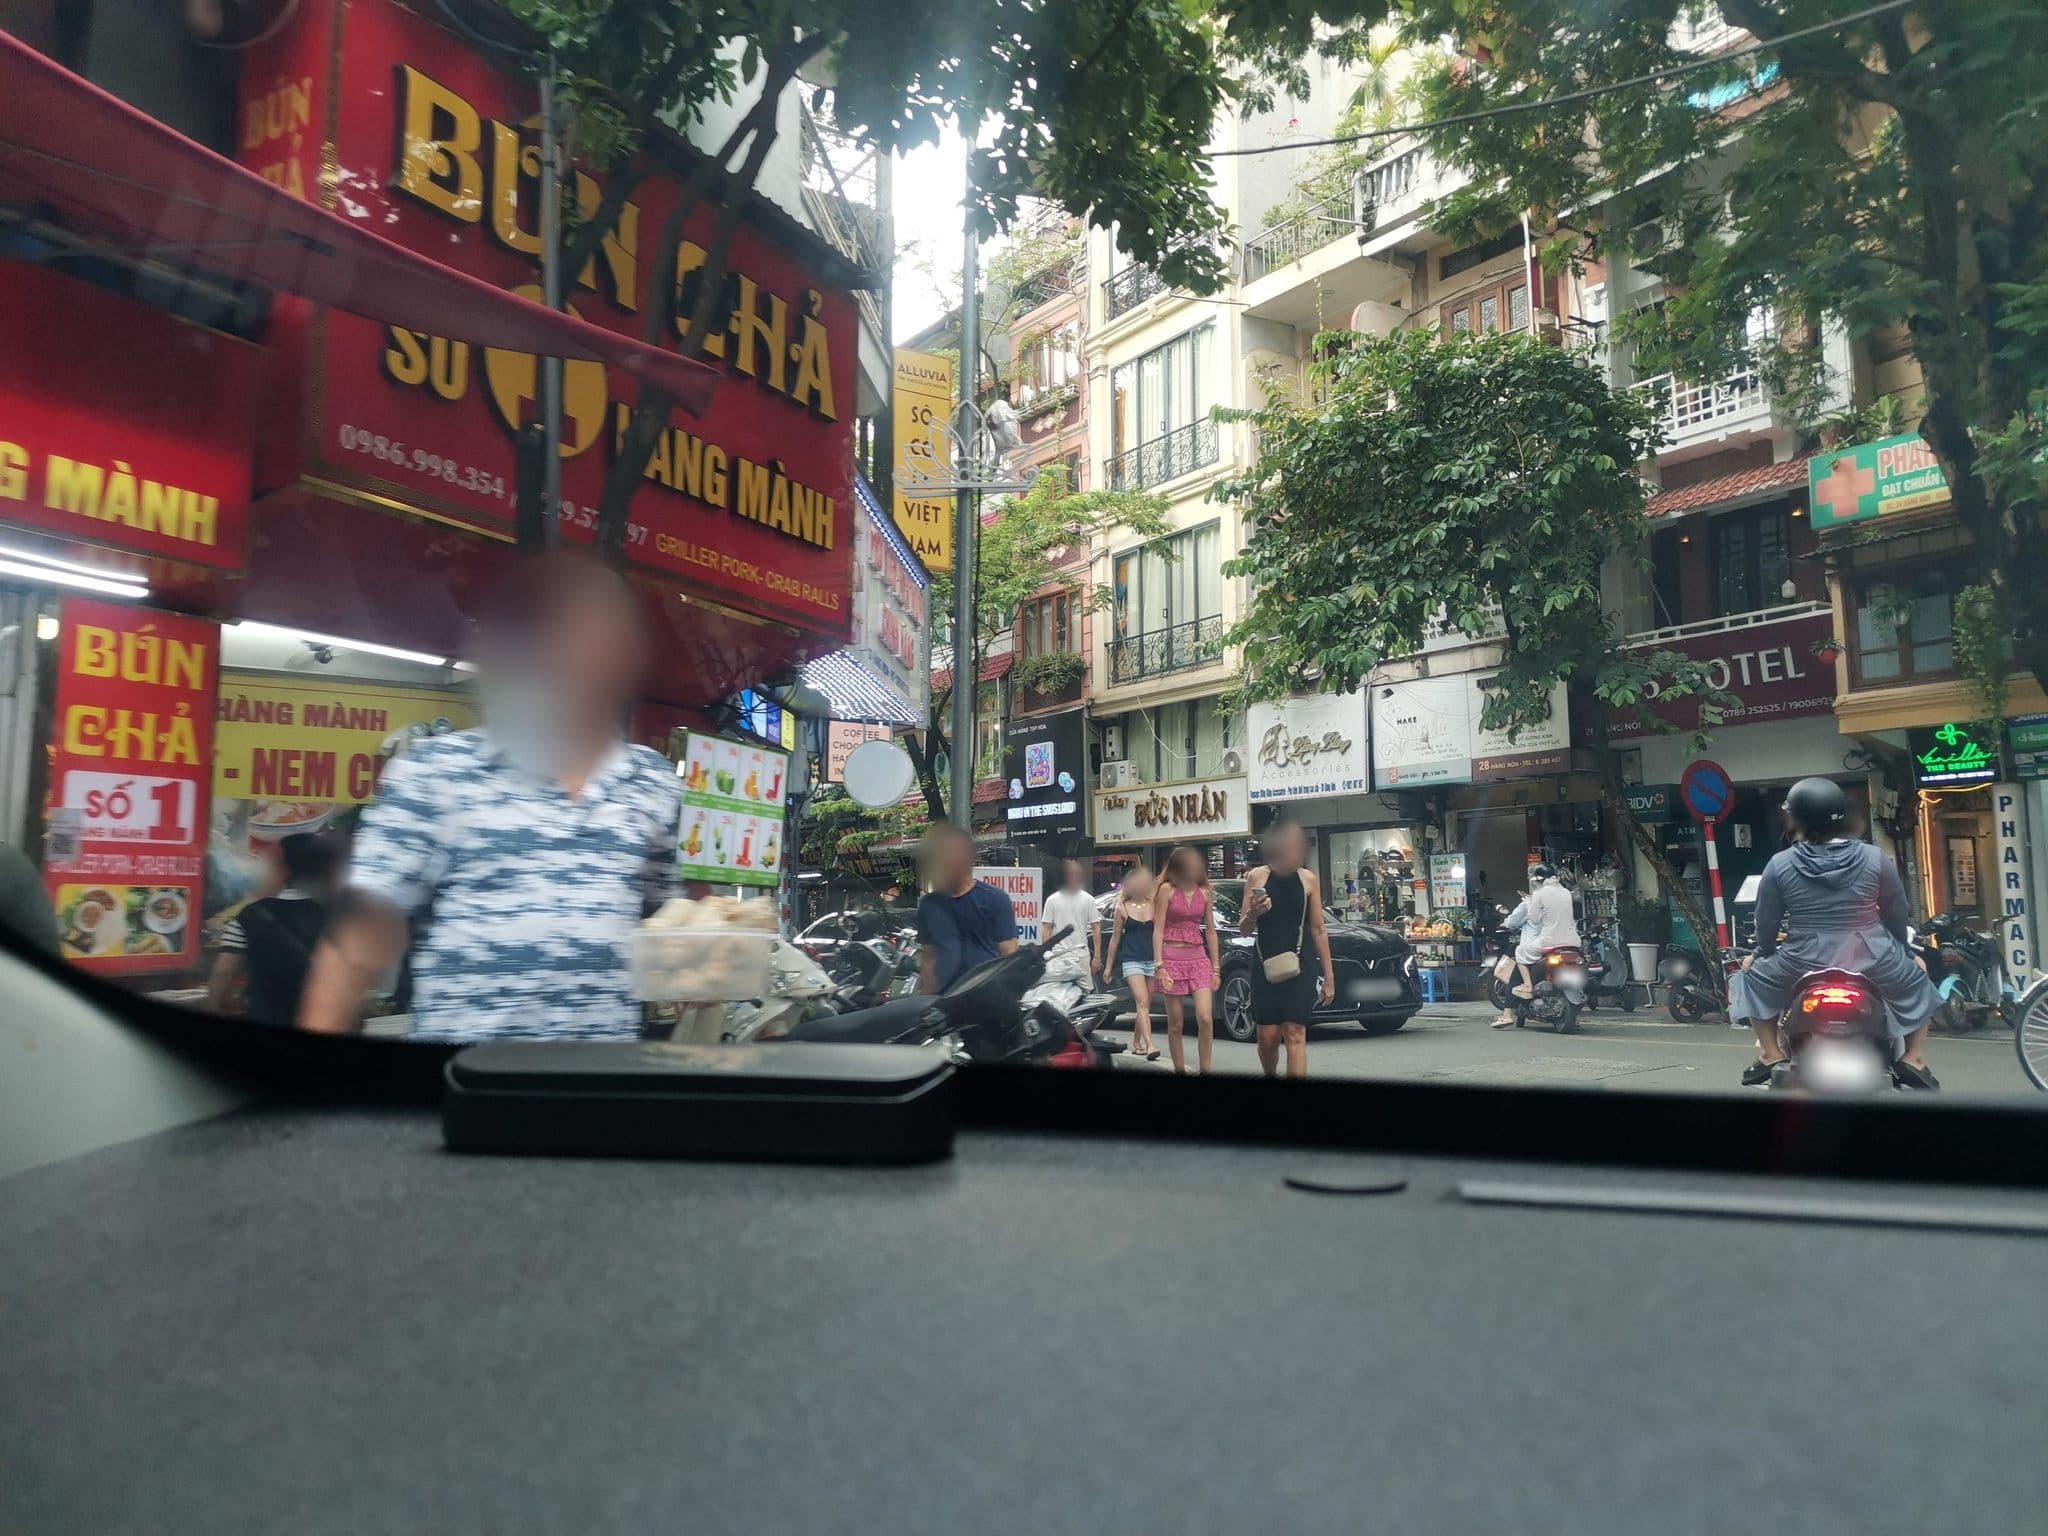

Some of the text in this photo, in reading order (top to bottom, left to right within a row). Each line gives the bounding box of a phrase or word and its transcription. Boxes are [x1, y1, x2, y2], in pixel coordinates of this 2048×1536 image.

[897, 363, 948, 383] ALLUVIA
[46, 454, 219, 546] MÀNH
[737, 458, 834, 551] MÀNH
[903, 500, 941, 525] VIỆT
[765, 570, 801, 598] CRAB
[72, 624, 206, 691] BÚN
[1703, 646, 1806, 692] OTEL
[303, 702, 388, 732] MÀNH
[1722, 708, 1746, 719] 0789
[1747, 703, 1781, 716] 252525
[63, 702, 201, 765] CHẢ
[1479, 760, 1490, 771] 28
[1916, 742, 1993, 765] Vanilla
[1925, 760, 1986, 773] THE BEAUTY
[251, 747, 337, 798] NEM
[1261, 764, 1351, 780] Accessories
[86, 780, 188, 841] SỐ 1
[1171, 784, 1228, 825] NHÂN
[1008, 873, 1034, 896] KIỆN
[1998, 794, 2027, 992] PHARMACY
[1011, 901, 1038, 921] HOẠI
[1016, 925, 1038, 940] PIN
